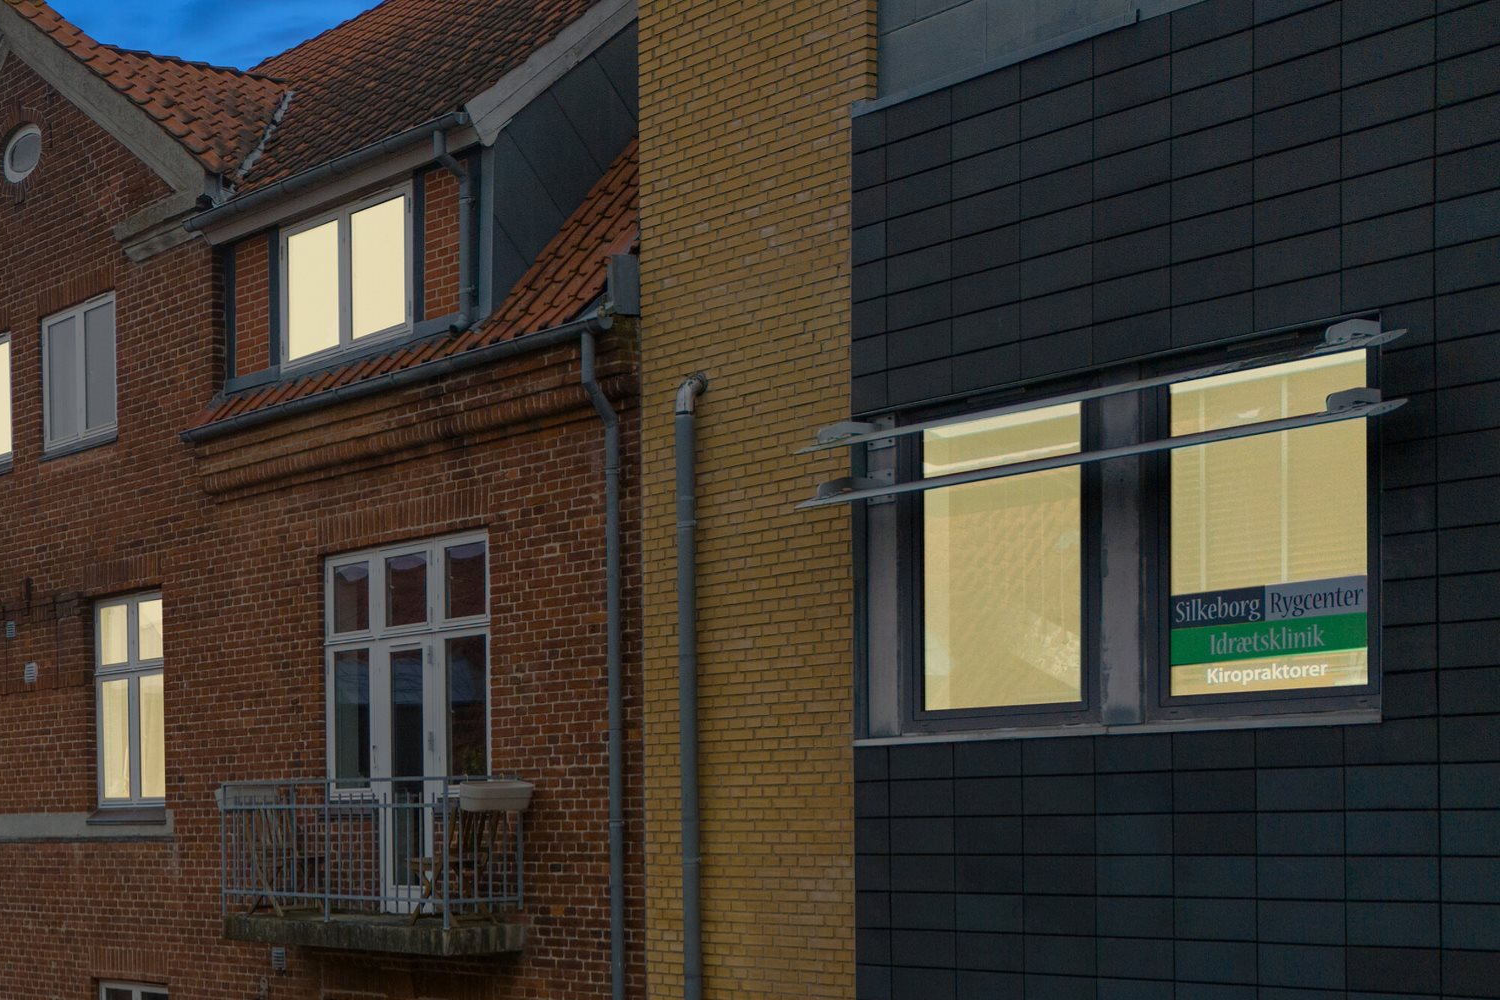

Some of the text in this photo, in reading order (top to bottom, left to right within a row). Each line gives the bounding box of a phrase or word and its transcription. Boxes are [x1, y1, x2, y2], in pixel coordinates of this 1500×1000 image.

[1175, 587, 1364, 622] Silkeborg Rygcenter
[1210, 624, 1325, 656] Idrætsklinik
[1206, 662, 1328, 686] Kiropraktorer
